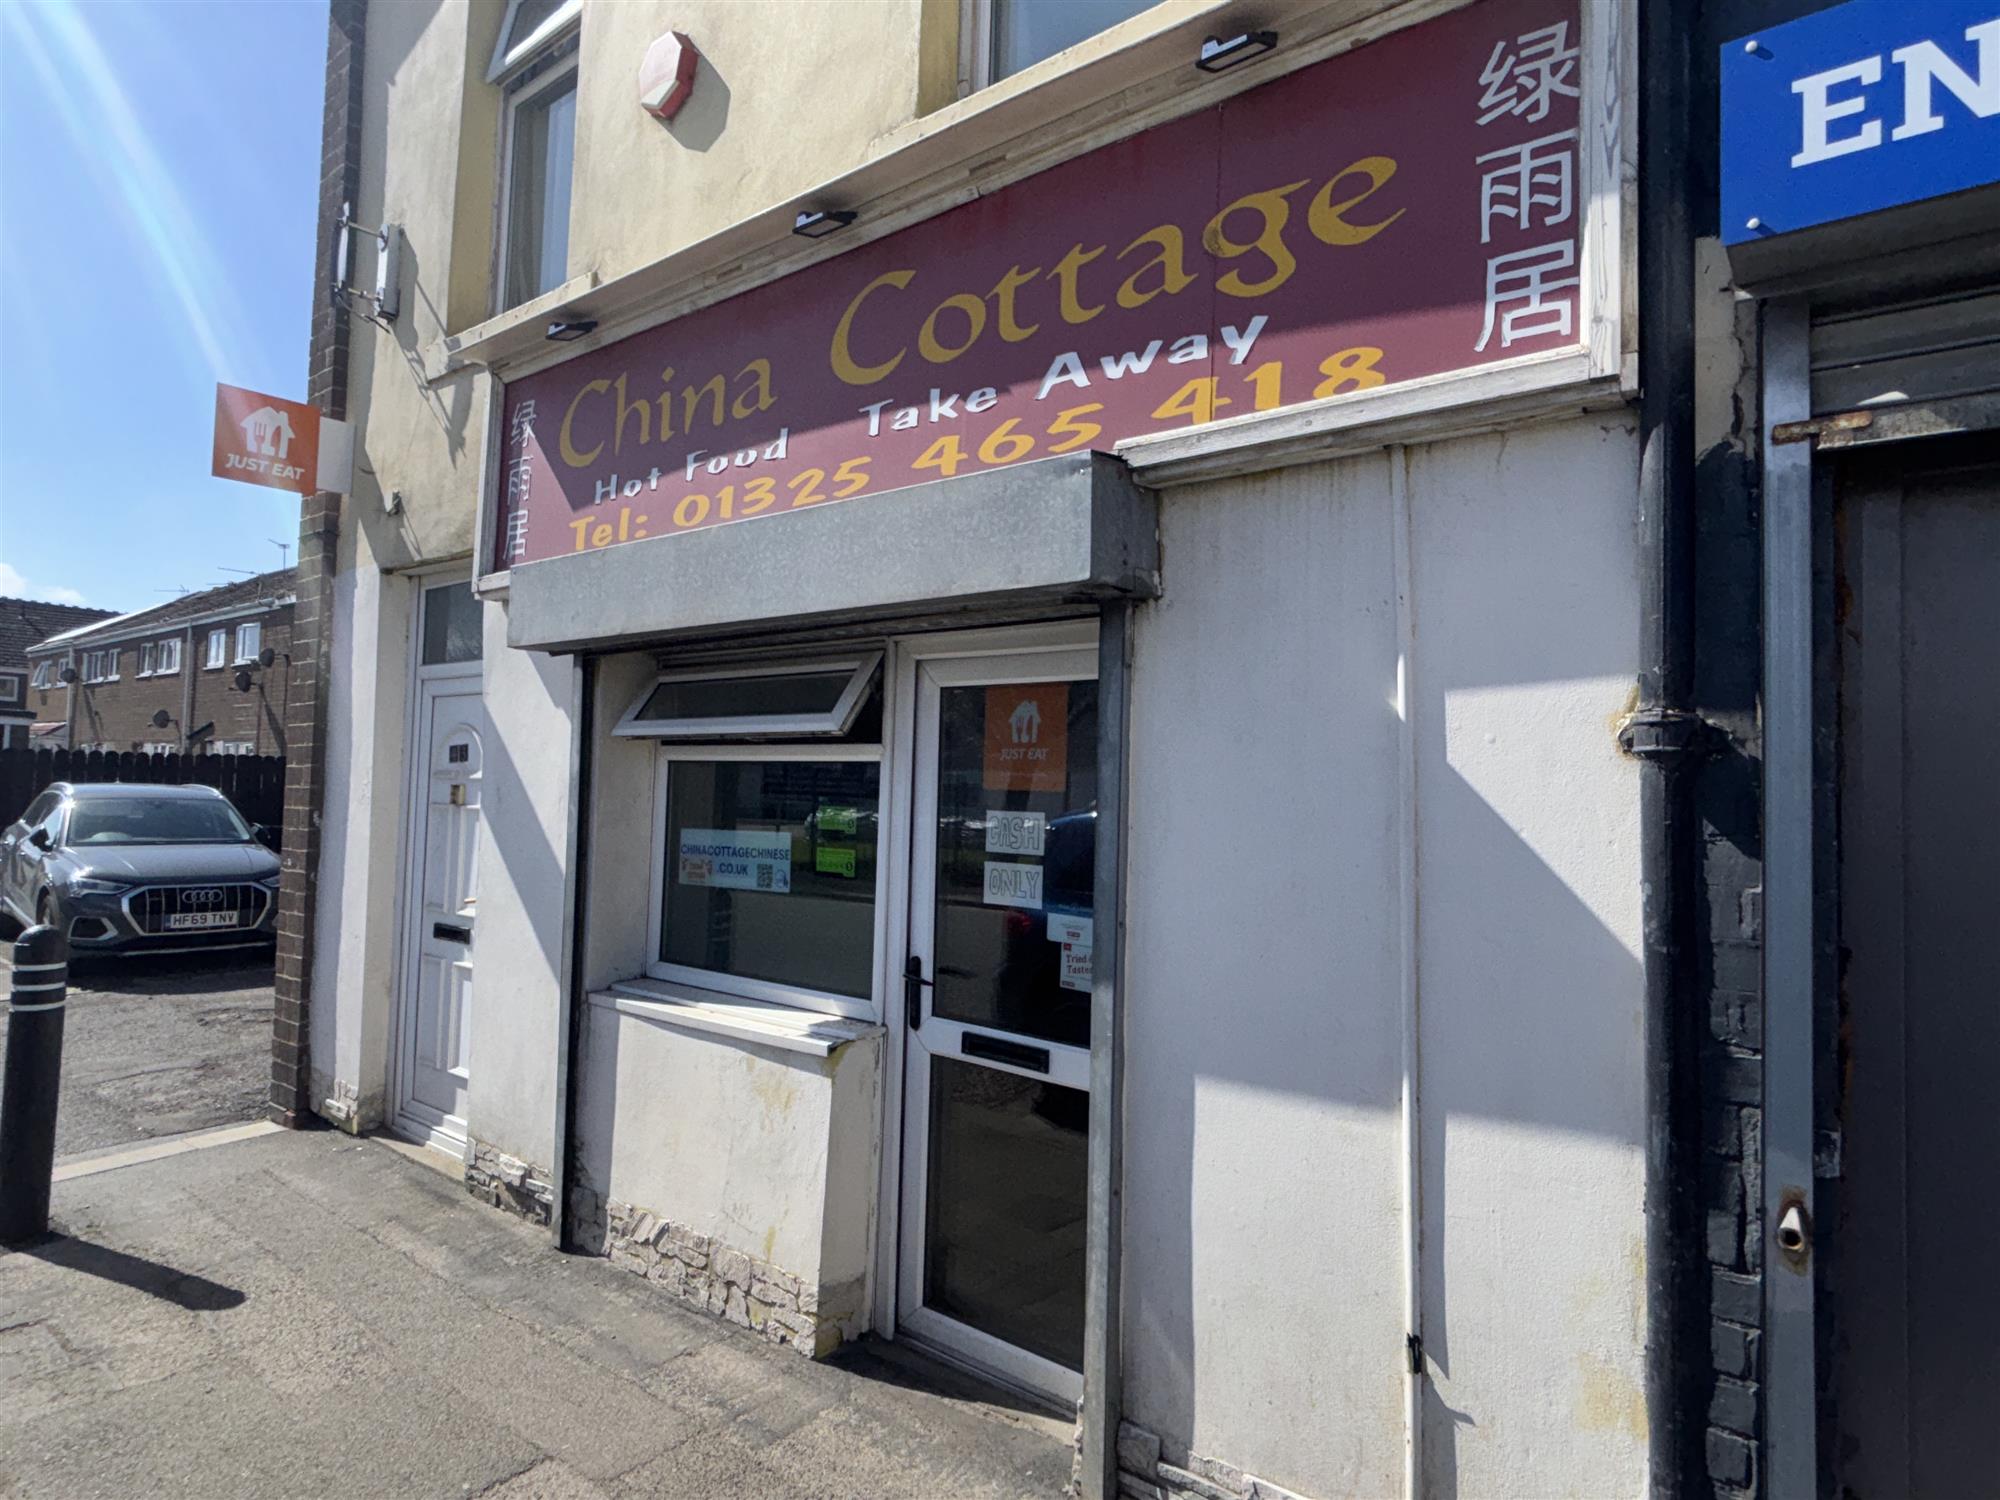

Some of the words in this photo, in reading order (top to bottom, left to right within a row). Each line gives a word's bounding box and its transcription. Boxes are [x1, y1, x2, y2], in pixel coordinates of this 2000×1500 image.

[1791, 18, 2000, 169] EN
[1474, 20, 1581, 353] 绿雨居
[559, 358, 779, 468] China
[830, 156, 1407, 386] Cottage
[594, 467, 663, 505] Hot
[685, 428, 789, 482] Food
[859, 387, 997, 438] Take
[1034, 315, 1269, 400] Away
[225, 453, 269, 473] JUST
[271, 463, 305, 480] EAT
[569, 508, 648, 551] Tel:
[673, 456, 872, 528] 01325
[911, 403, 1105, 477] 465
[1151, 347, 1387, 424] 418
[502, 399, 537, 560] 绿雨居
[1000, 747, 1026, 761] JUST
[1027, 747, 1049, 761] EAT
[988, 815, 1041, 850] CASH
[680, 843, 790, 861] CHINACOTTAGECHINESE
[989, 868, 1040, 900] ONLY
[173, 914, 208, 926] HF69
[212, 912, 235, 923] TNV
[1066, 965, 1090, 975] Taste
